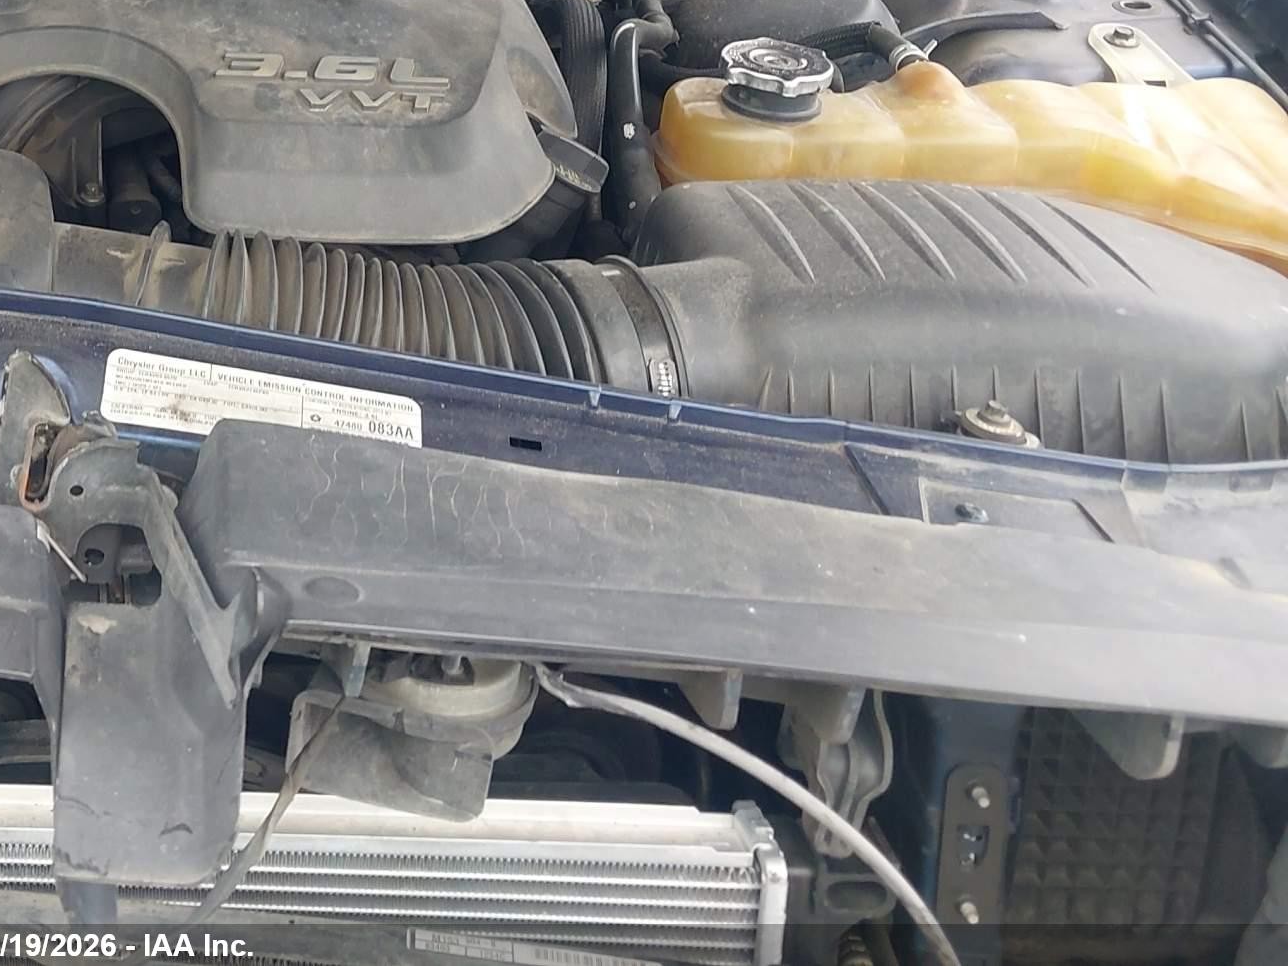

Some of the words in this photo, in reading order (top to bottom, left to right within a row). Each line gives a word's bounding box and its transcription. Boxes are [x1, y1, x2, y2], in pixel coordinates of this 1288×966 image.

[213, 51, 451, 90] 3.6L
[298, 88, 446, 114] VVT
[117, 356, 155, 371] Chrysler
[158, 364, 186, 377] Group
[188, 368, 206, 378] LLC
[217, 372, 254, 385] VEHICLE
[257, 378, 302, 394] EMISSION
[304, 387, 346, 402] CONTROL
[349, 395, 414, 412] INFORMATION
[368, 420, 414, 440] 083AA
